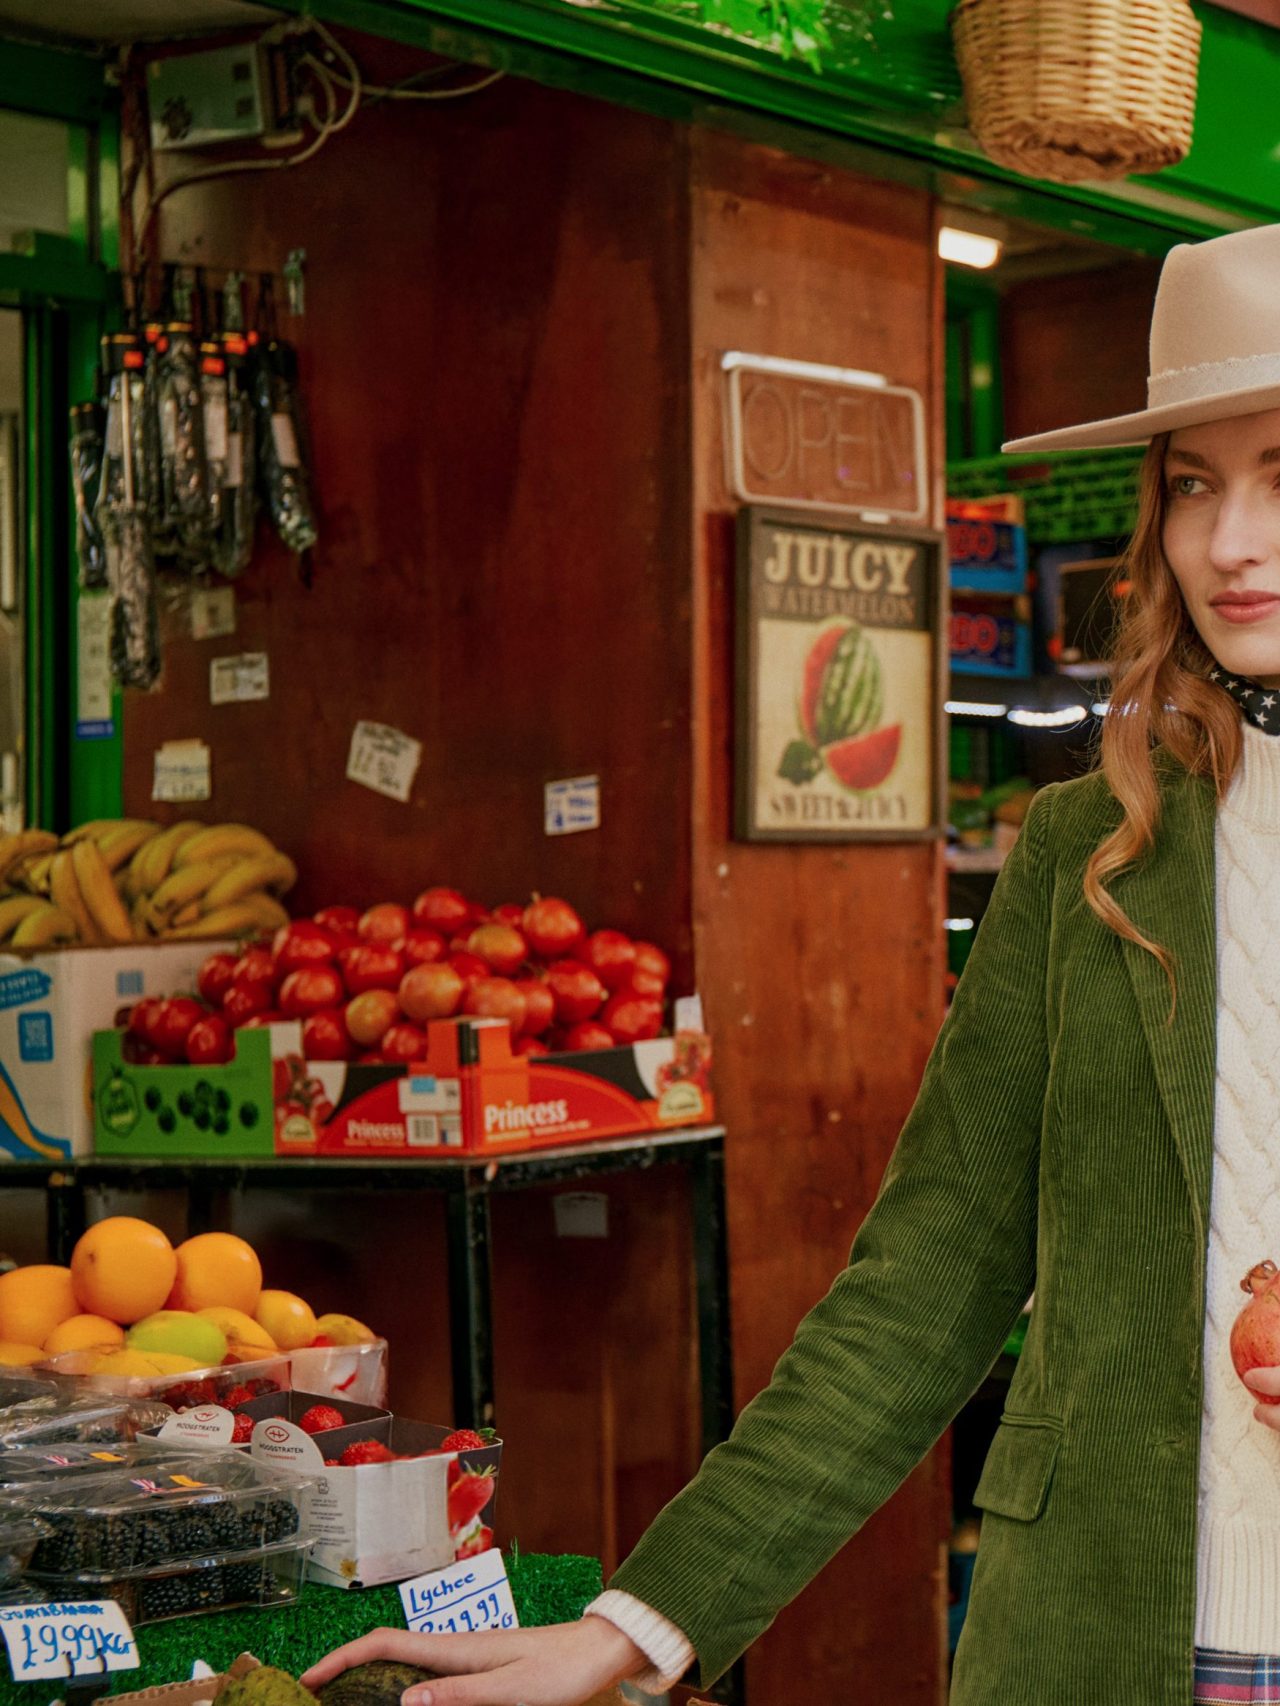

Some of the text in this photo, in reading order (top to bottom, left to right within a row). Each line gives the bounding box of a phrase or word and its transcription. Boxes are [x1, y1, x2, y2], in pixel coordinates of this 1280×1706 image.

[744, 382, 913, 491] OPEN
[765, 531, 917, 595] JUICY
[484, 1099, 568, 1133] Princess
[409, 1572, 476, 1614] Lychee
